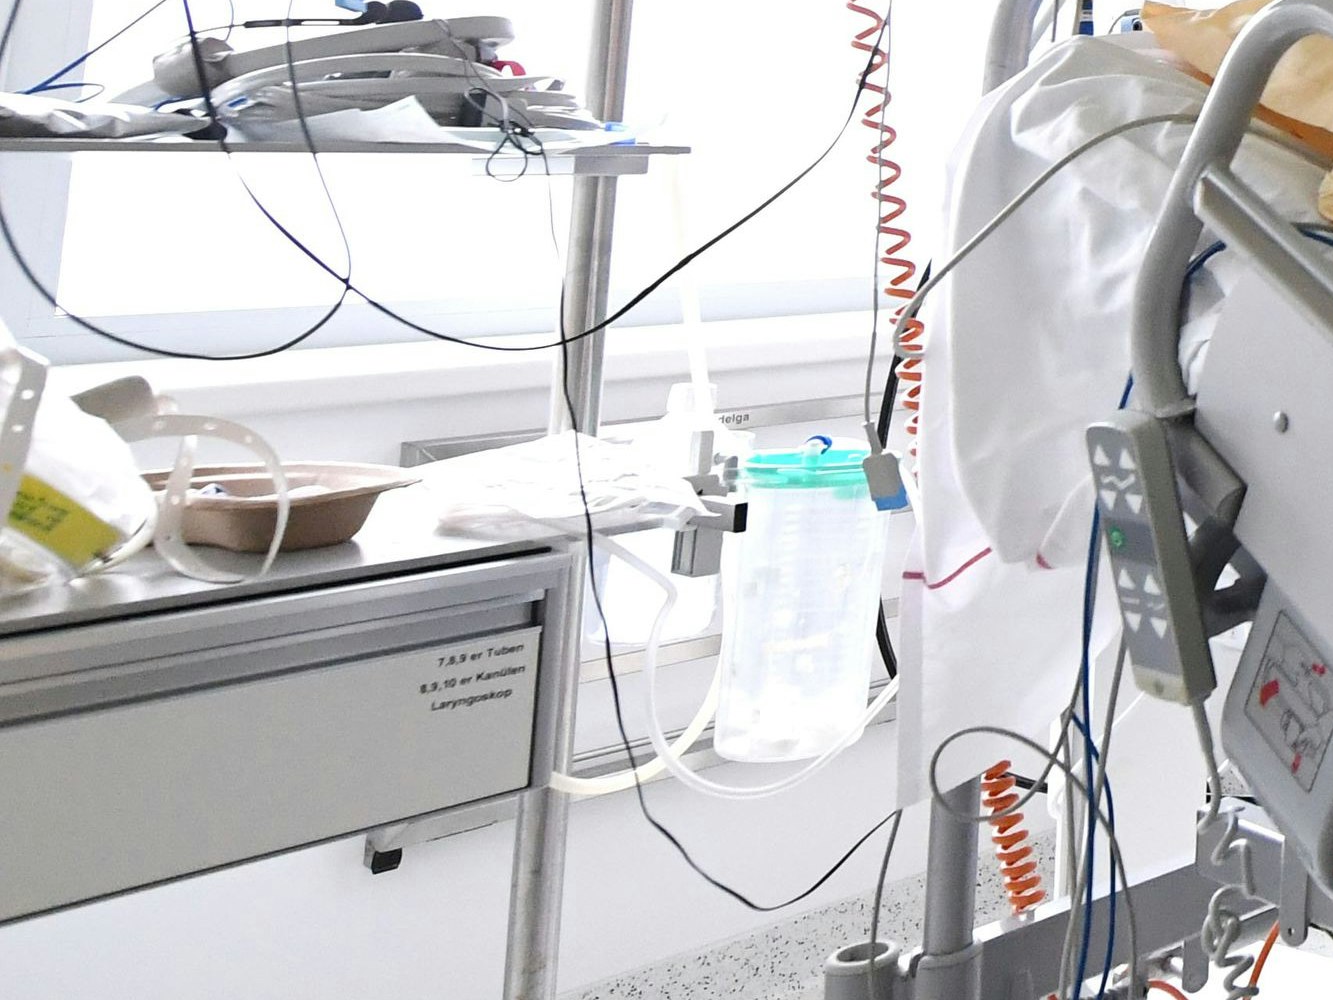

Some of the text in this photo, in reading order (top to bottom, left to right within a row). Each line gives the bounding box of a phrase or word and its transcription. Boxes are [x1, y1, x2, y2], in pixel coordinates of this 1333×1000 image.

[470, 651, 483, 661] er
[487, 644, 525, 658] Tuben
[460, 676, 473, 686] er
[431, 688, 513, 712] Laryngoskop
